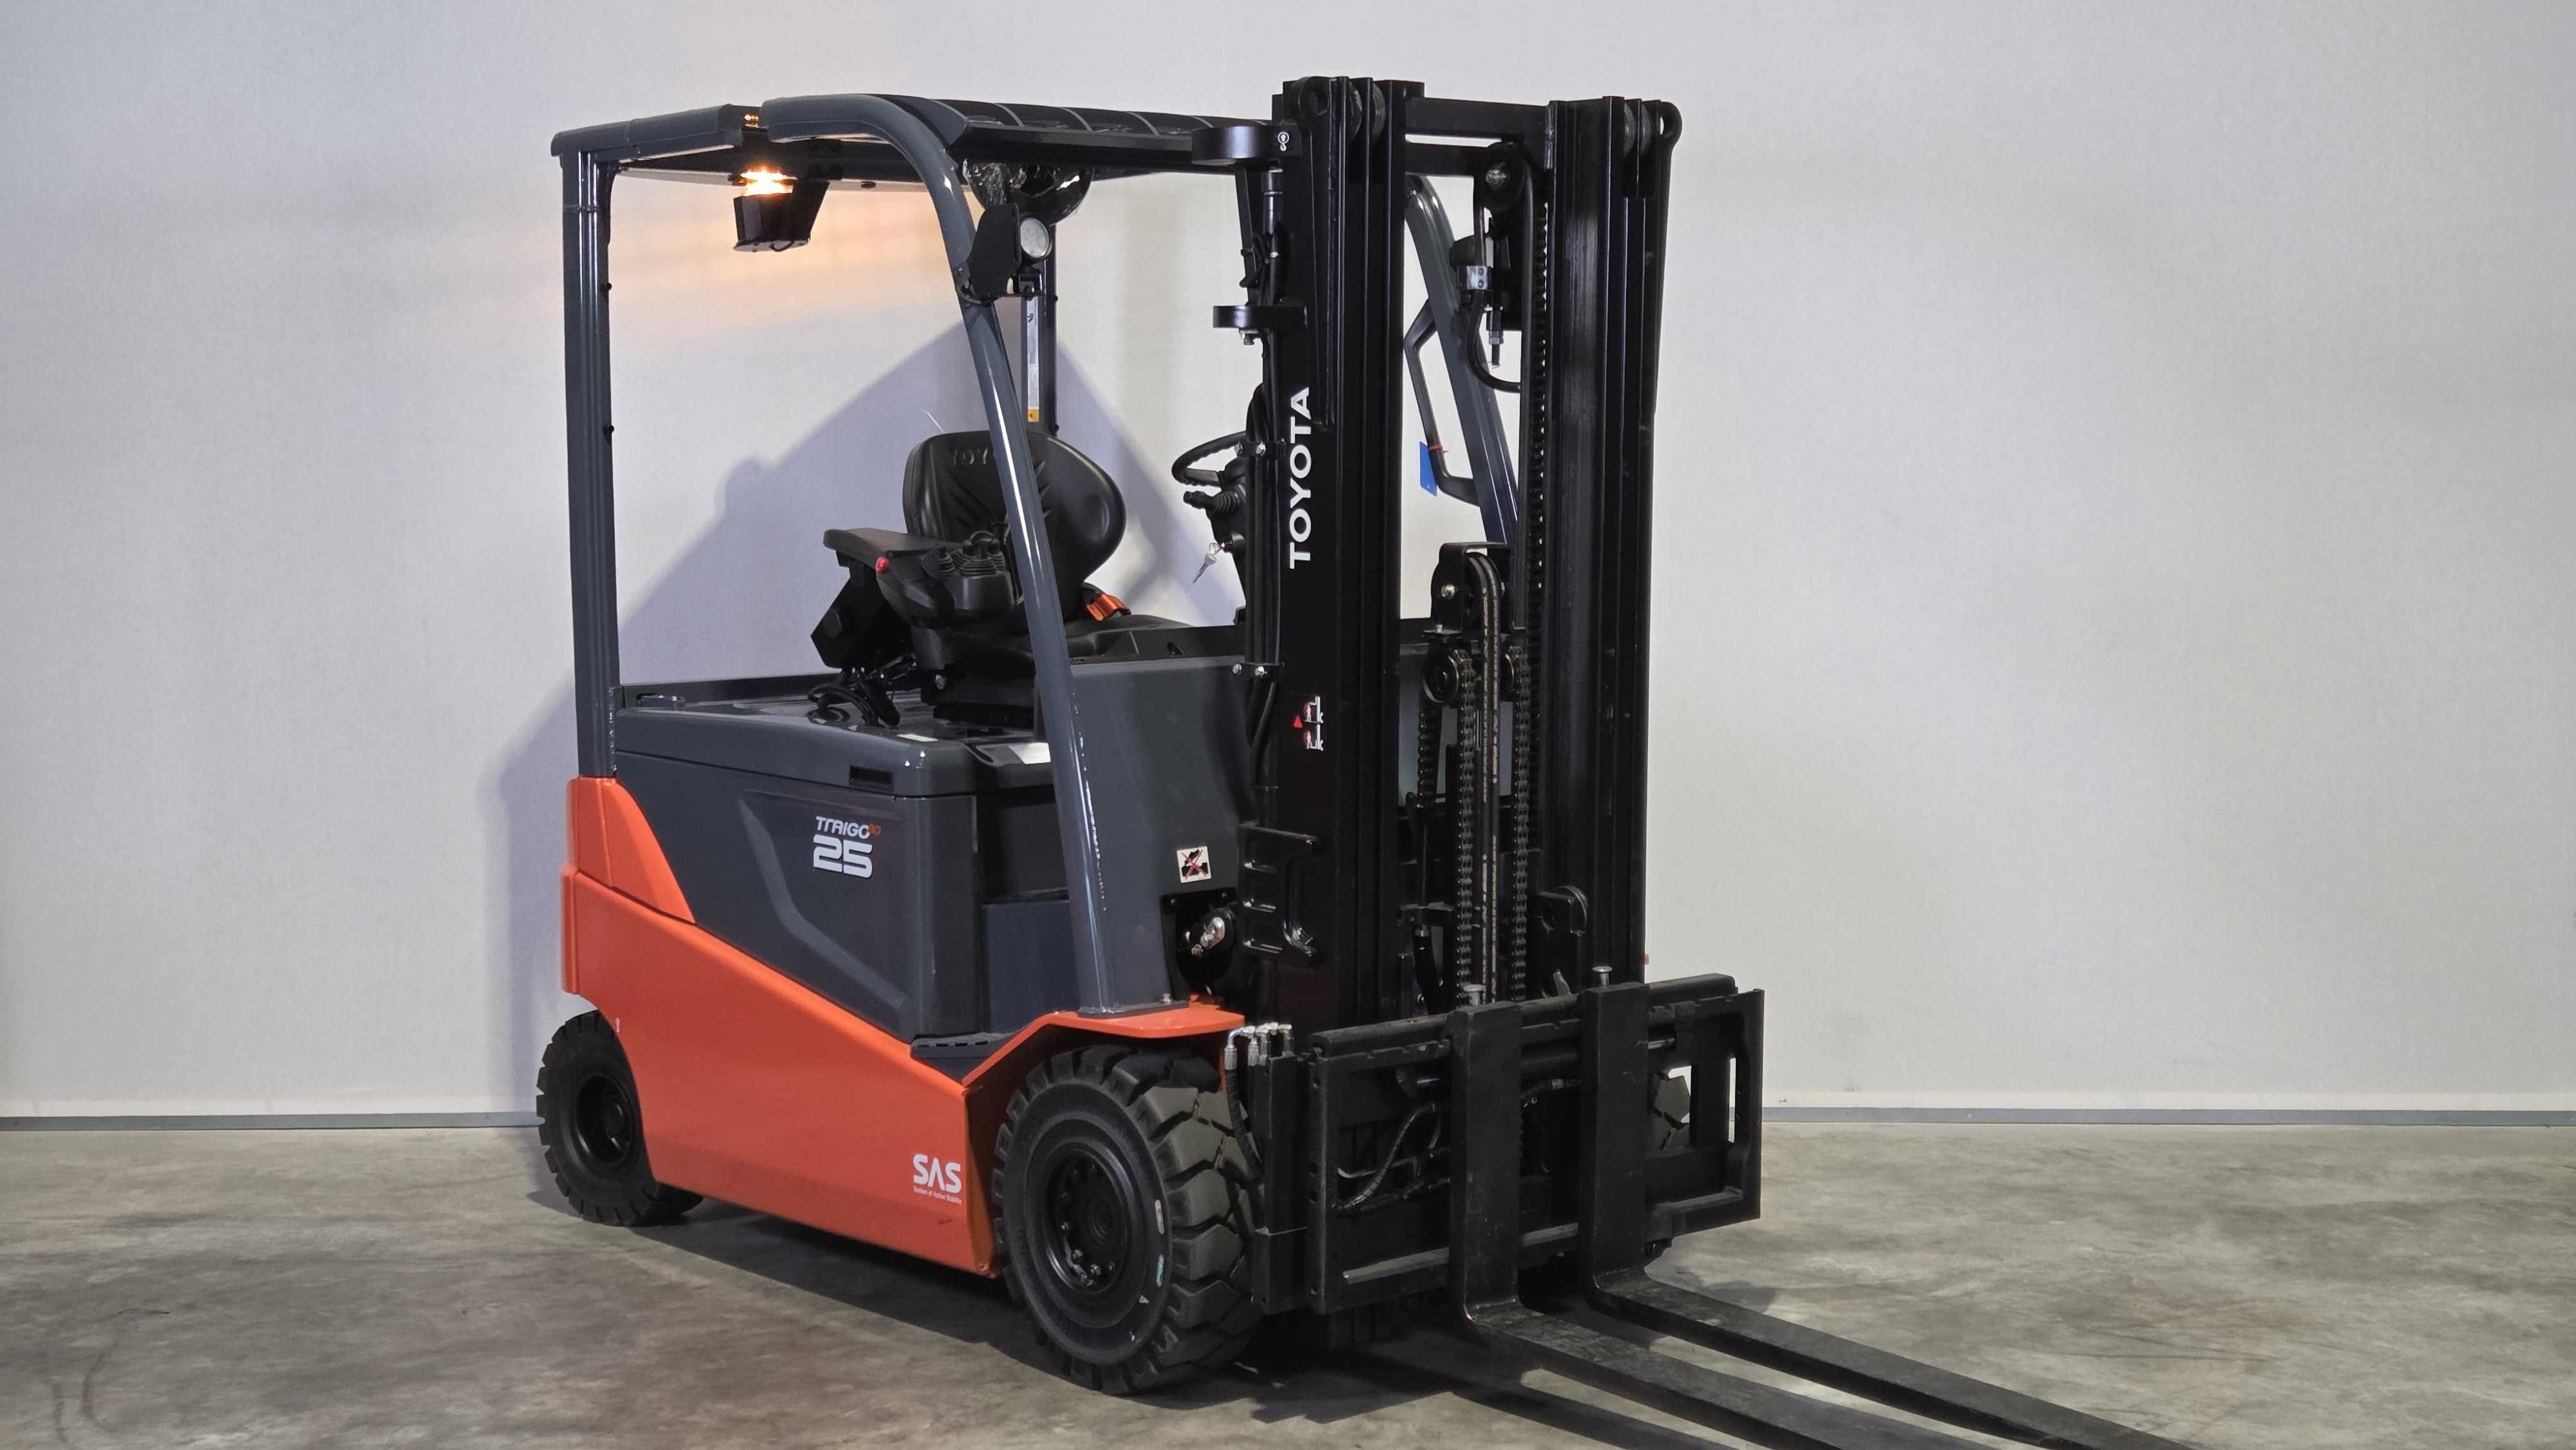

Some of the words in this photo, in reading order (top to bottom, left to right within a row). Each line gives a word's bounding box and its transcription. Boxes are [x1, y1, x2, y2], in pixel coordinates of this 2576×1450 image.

[1290, 387, 1311, 569] TOYOTA
[813, 834, 872, 878] 25
[913, 1154, 961, 1194] SAS
